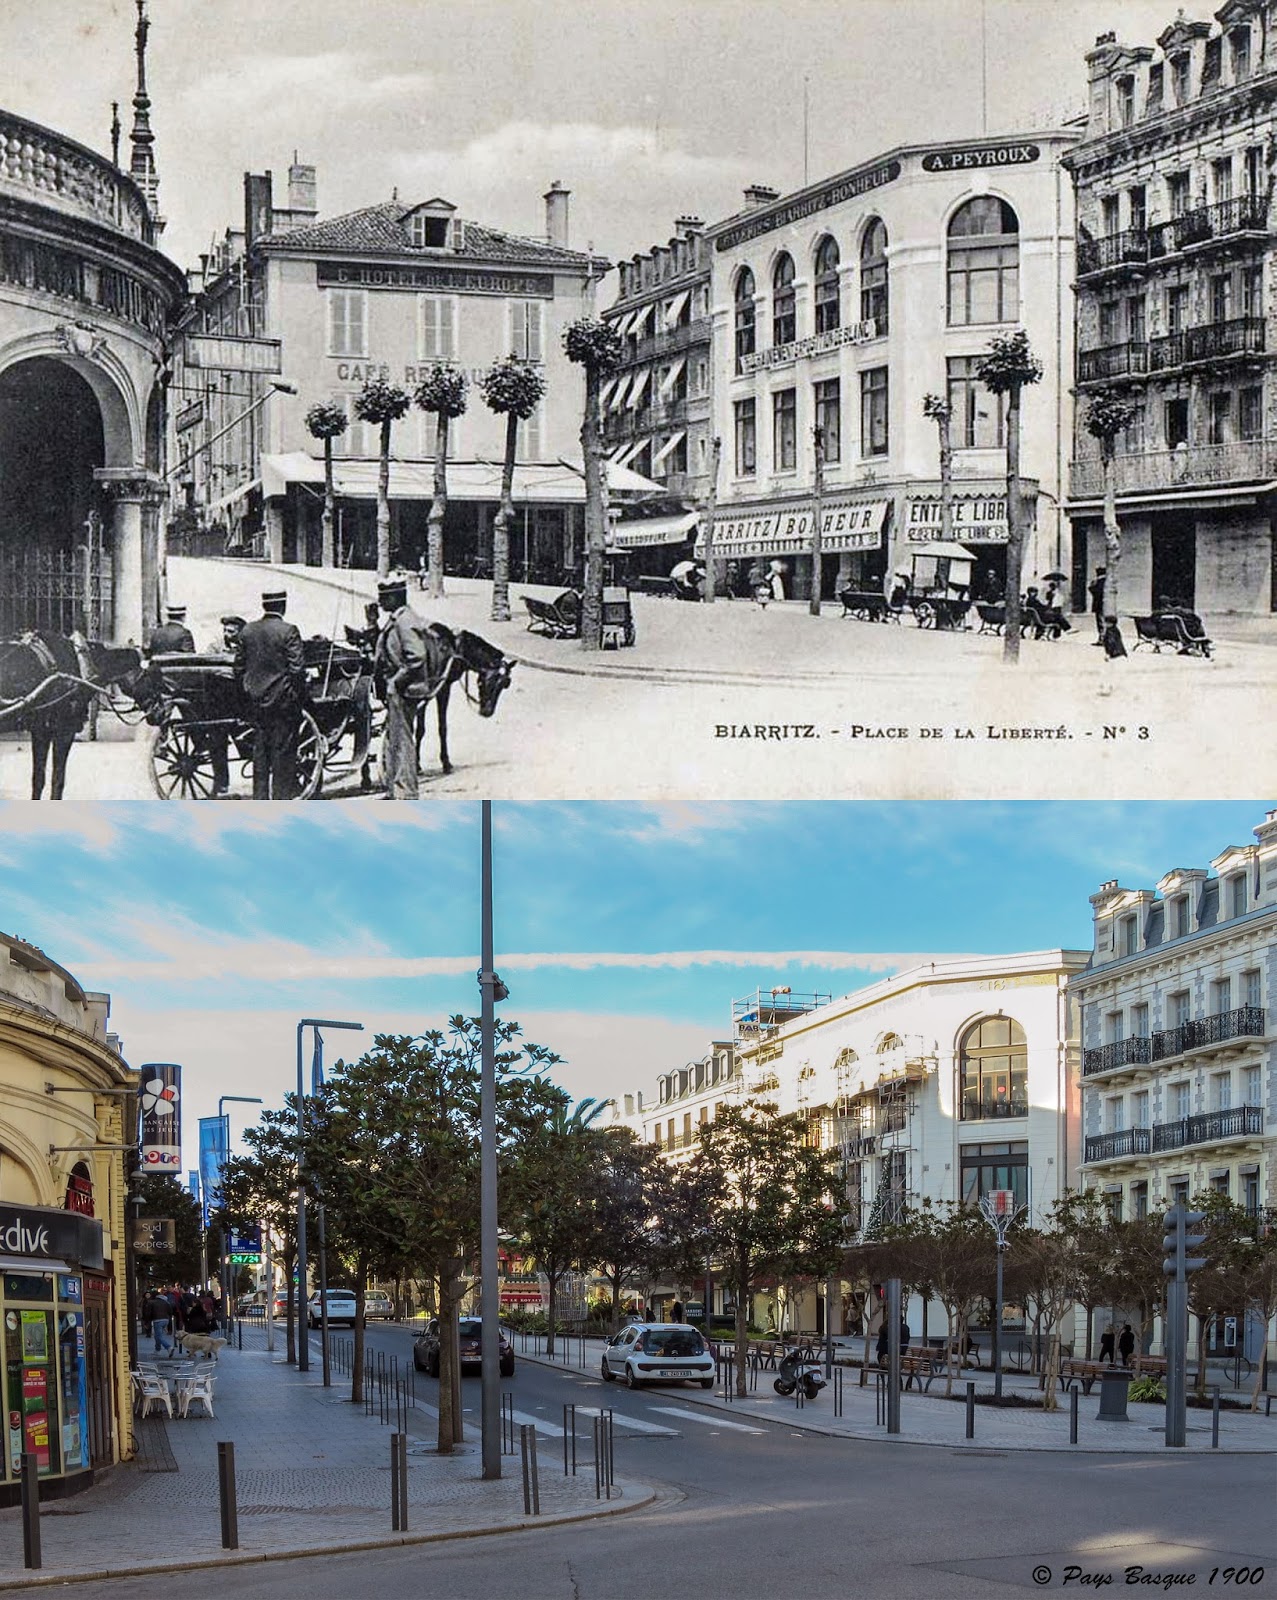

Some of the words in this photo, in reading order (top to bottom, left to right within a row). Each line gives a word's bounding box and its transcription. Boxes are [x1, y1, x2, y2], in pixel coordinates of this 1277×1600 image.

[952, 146, 1031, 167] PEYROUX
[911, 503, 965, 523] ENTE
[974, 501, 1005, 521] LIBR
[142, 1223, 161, 1232] Sud
[133, 1241, 174, 1252] express
[232, 1255, 259, 1263] 24/24
